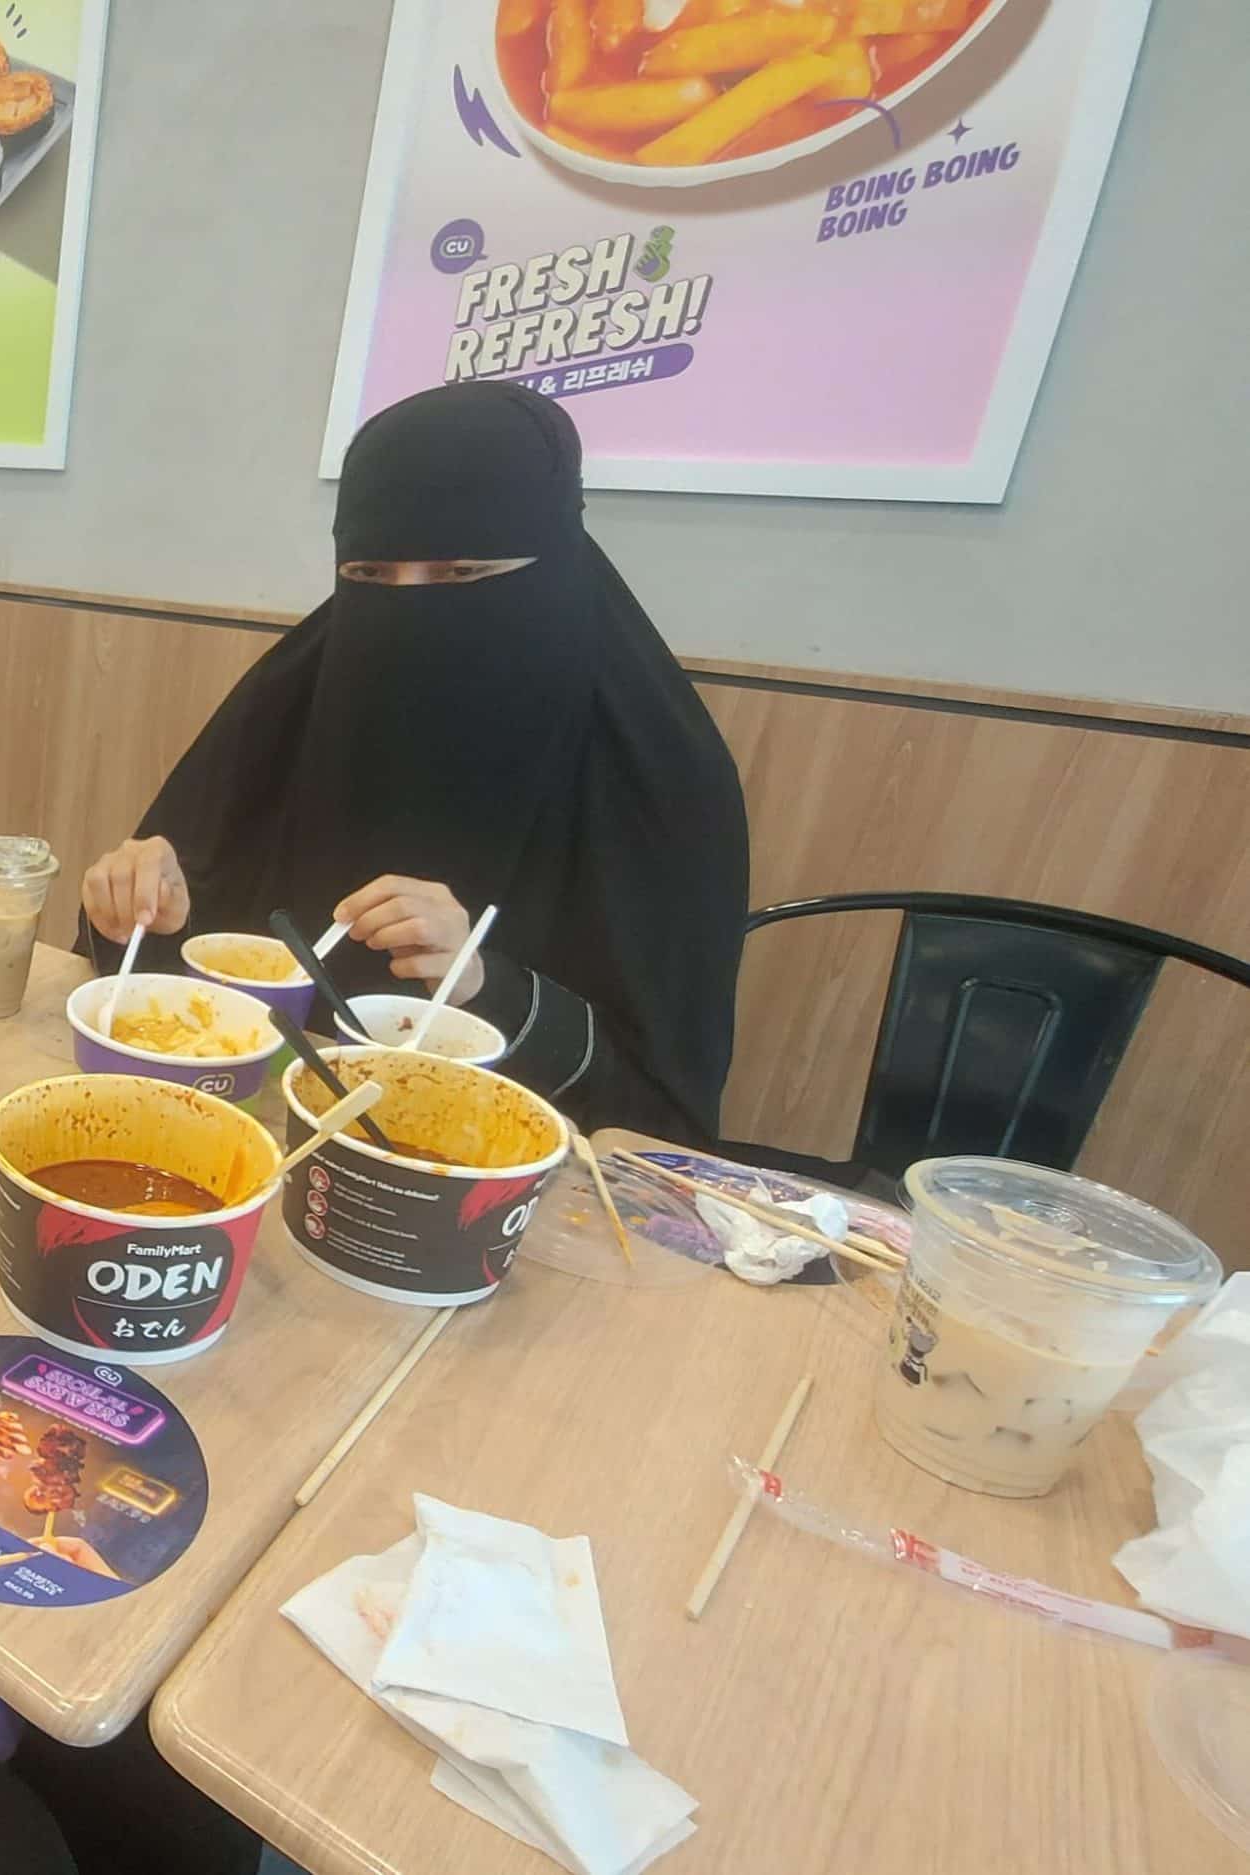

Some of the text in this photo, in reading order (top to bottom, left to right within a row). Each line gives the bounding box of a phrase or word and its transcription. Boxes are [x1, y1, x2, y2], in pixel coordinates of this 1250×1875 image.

[824, 142, 1020, 212] BOING BOING
[816, 200, 908, 243] BOING
[446, 241, 469, 254] CU
[454, 232, 635, 328] FRESH
[444, 273, 713, 385] REFRESH!
[562, 355, 655, 391] 리프레쉬
[201, 1079, 228, 1092] CU
[502, 1196, 539, 1237] OD
[126, 1243, 203, 1258] FamilyMart
[86, 1256, 223, 1301] ODEN
[111, 1317, 187, 1338] おでん
